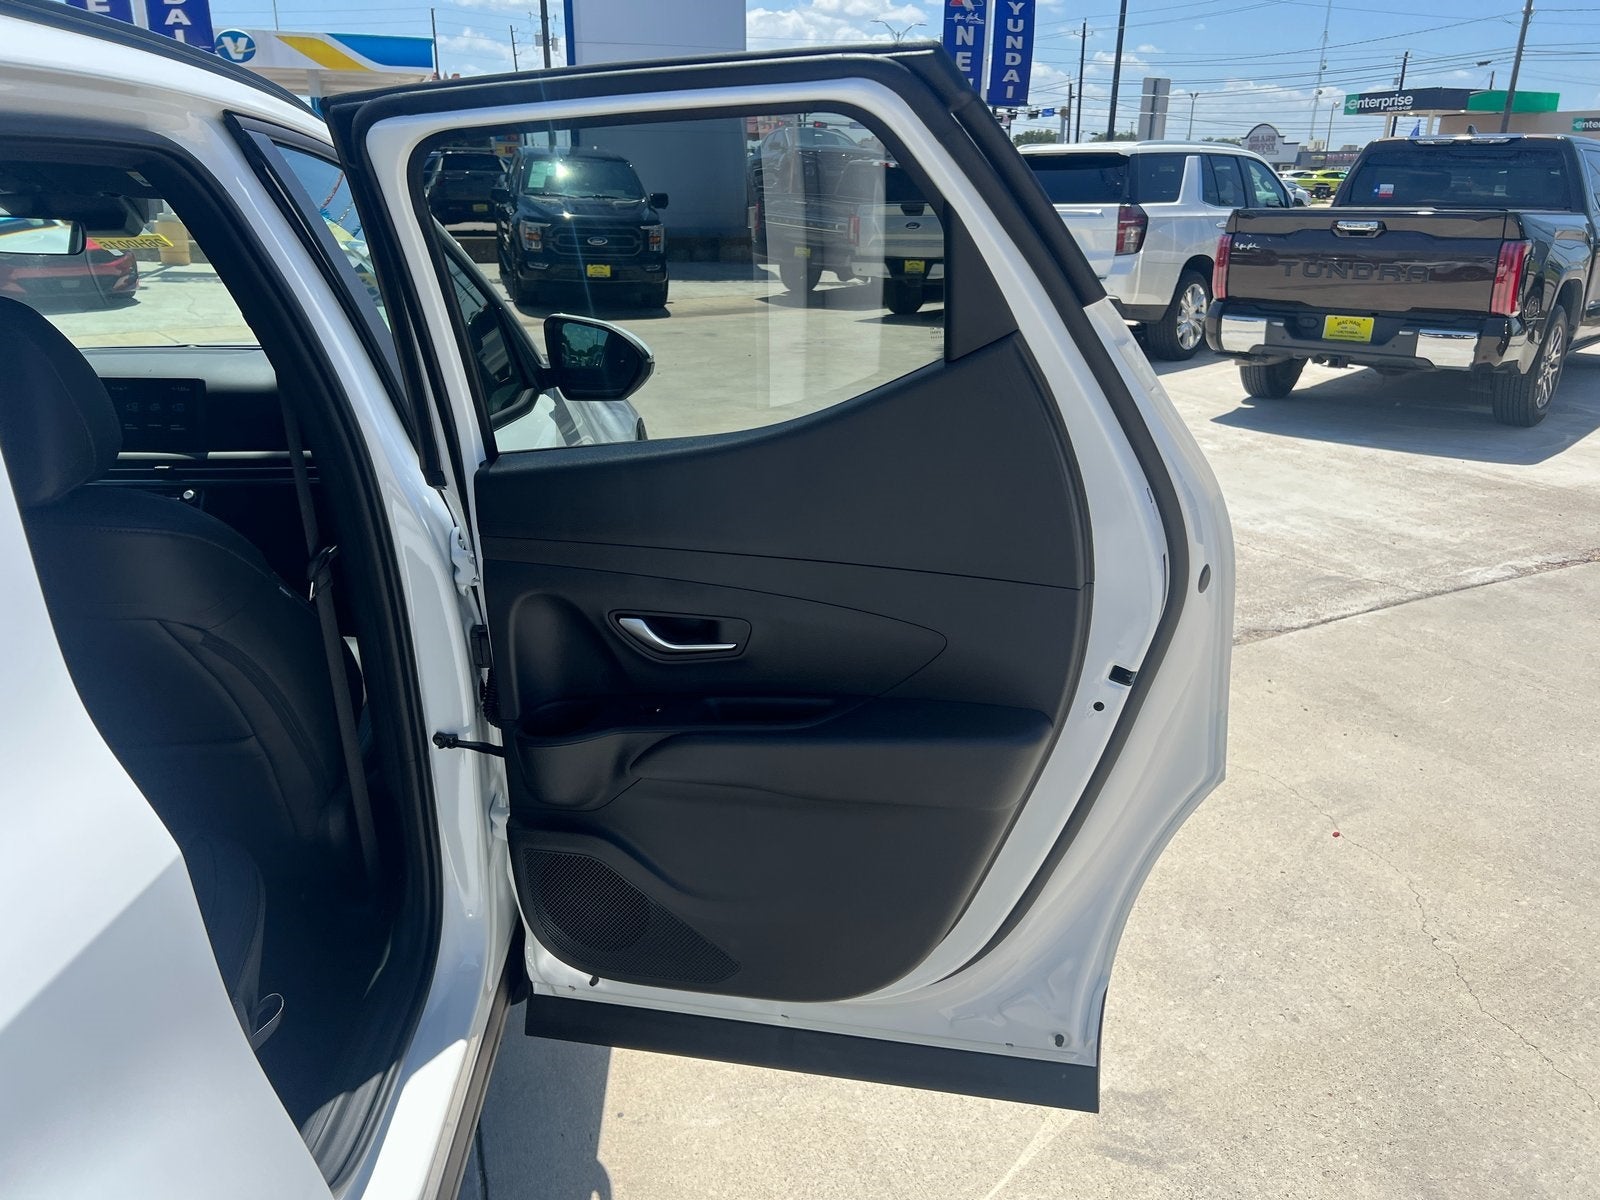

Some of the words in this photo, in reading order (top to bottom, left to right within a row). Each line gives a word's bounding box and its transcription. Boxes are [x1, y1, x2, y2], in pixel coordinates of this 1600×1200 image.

[955, 25, 975, 87] NE
[1346, 94, 1413, 111] enterprise
[1279, 260, 1431, 283] TUNDRA
